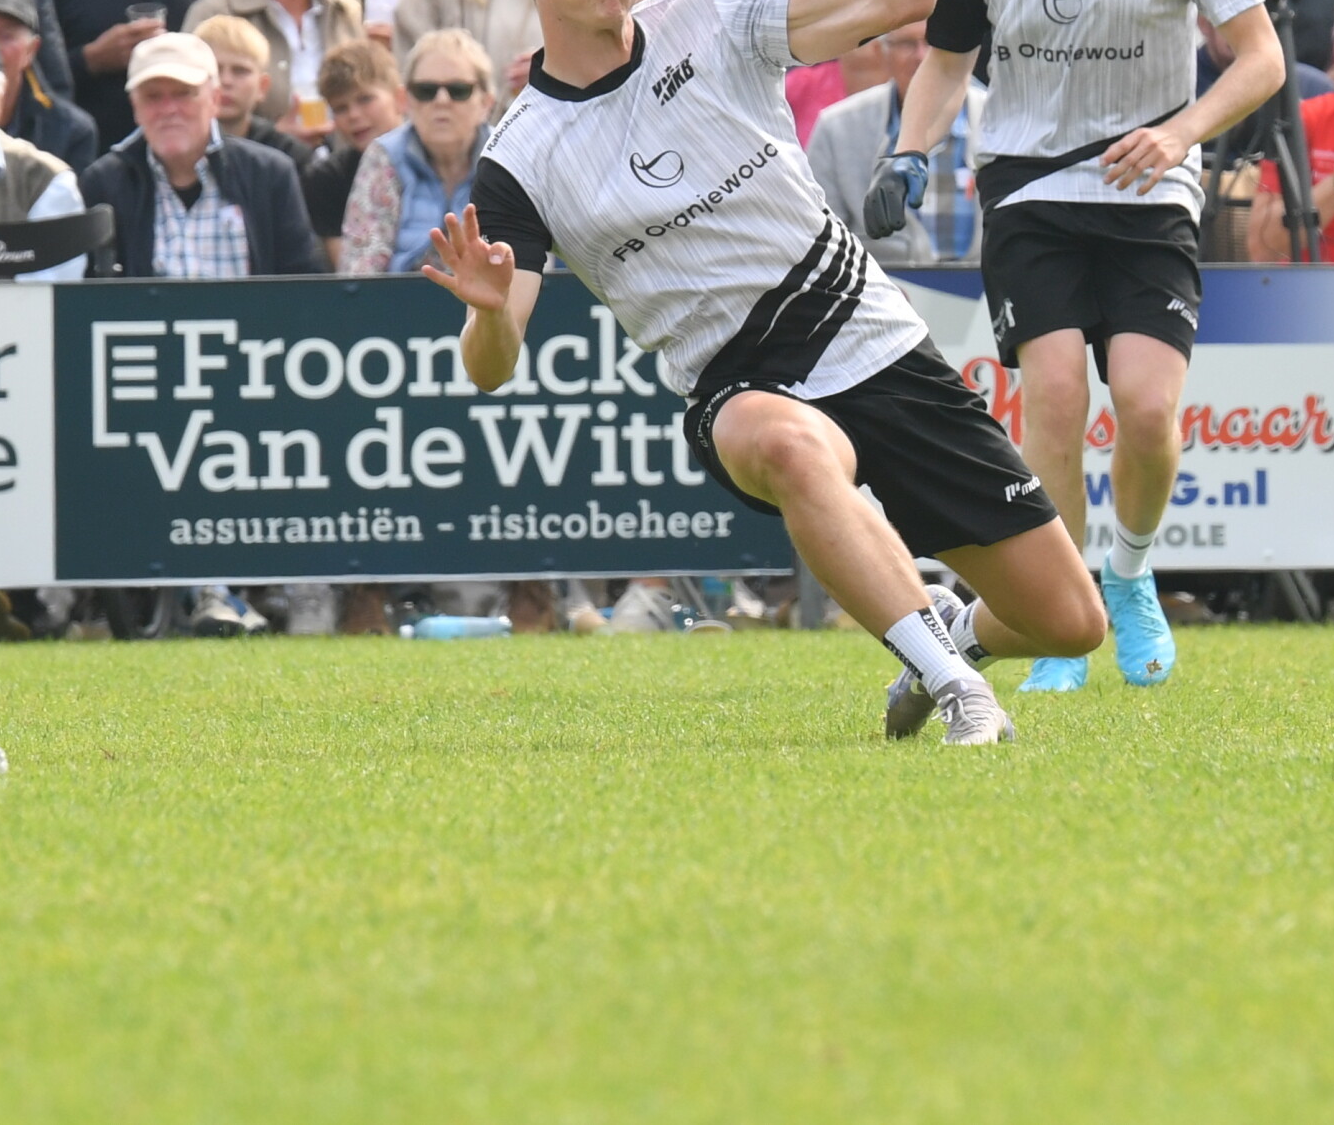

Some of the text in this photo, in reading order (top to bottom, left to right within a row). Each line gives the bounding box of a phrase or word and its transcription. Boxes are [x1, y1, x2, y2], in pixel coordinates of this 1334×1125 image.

[994, 39, 1145, 67] B Oranjewoud
[486, 102, 531, 152] Rabobank
[613, 238, 645, 262] FB
[172, 305, 693, 400] Froonck
[135, 409, 330, 492] Van
[346, 406, 465, 490] de
[468, 400, 707, 488] Witt
[170, 507, 423, 546] assurantiën
[468, 500, 734, 541] risicobeheer
